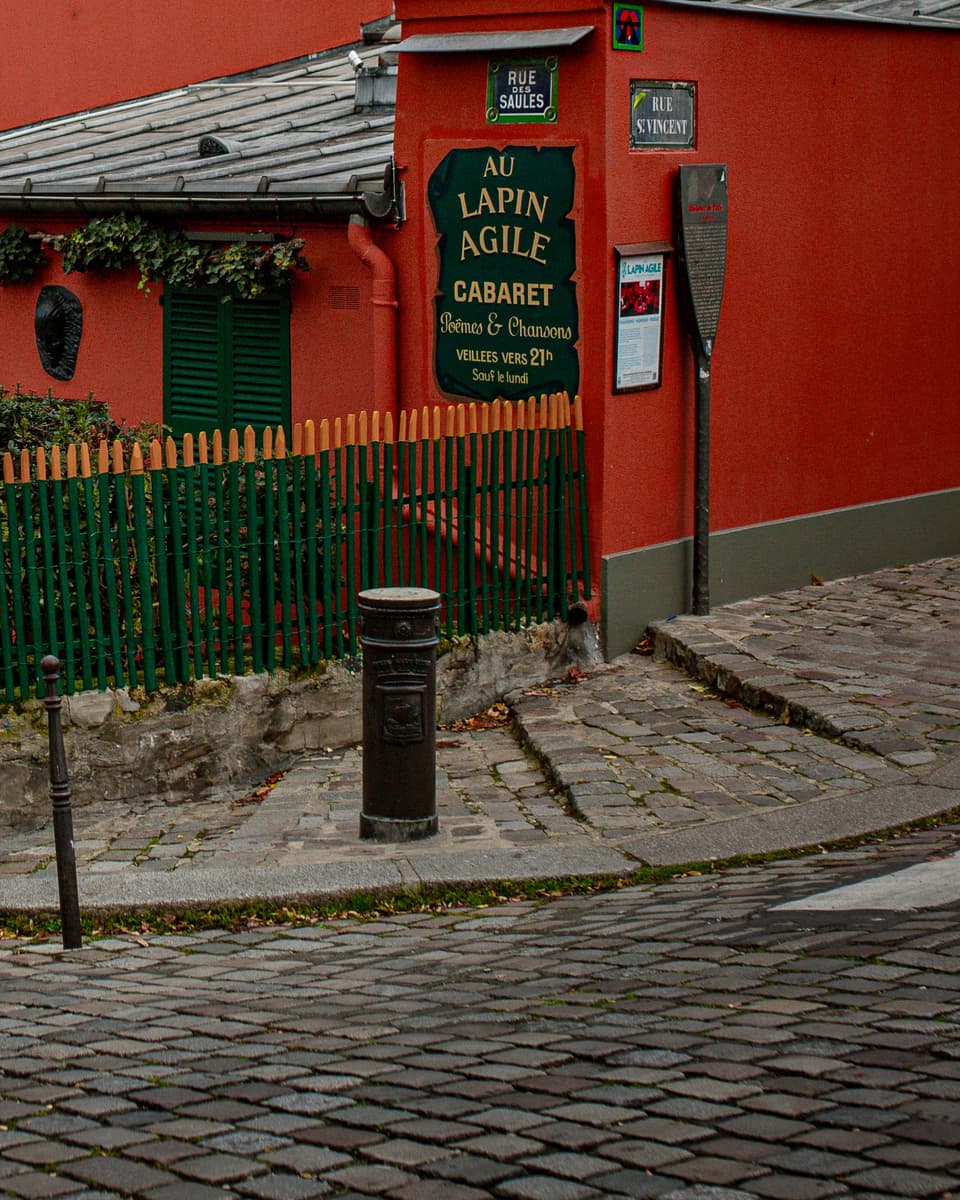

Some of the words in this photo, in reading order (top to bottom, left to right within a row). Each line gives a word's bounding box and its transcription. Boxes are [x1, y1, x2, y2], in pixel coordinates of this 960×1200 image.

[508, 70, 537, 86] RUE
[500, 94, 545, 110] SAULES
[652, 96, 673, 112] RUE
[647, 119, 688, 135] VINCENT
[482, 155, 516, 177] AU
[457, 187, 550, 224] LAPIN
[460, 224, 551, 265] AGILE
[628, 264, 644, 275] LAPIN
[645, 262, 662, 273] AGILE
[453, 280, 554, 306] CABARET
[487, 312, 503, 336] &
[508, 316, 572, 340] Chansons
[501, 351, 528, 365] VERS
[530, 347, 553, 367] 21h
[472, 368, 495, 382] Sauf
[497, 370, 505, 383] le
[506, 370, 529, 384] lundi
